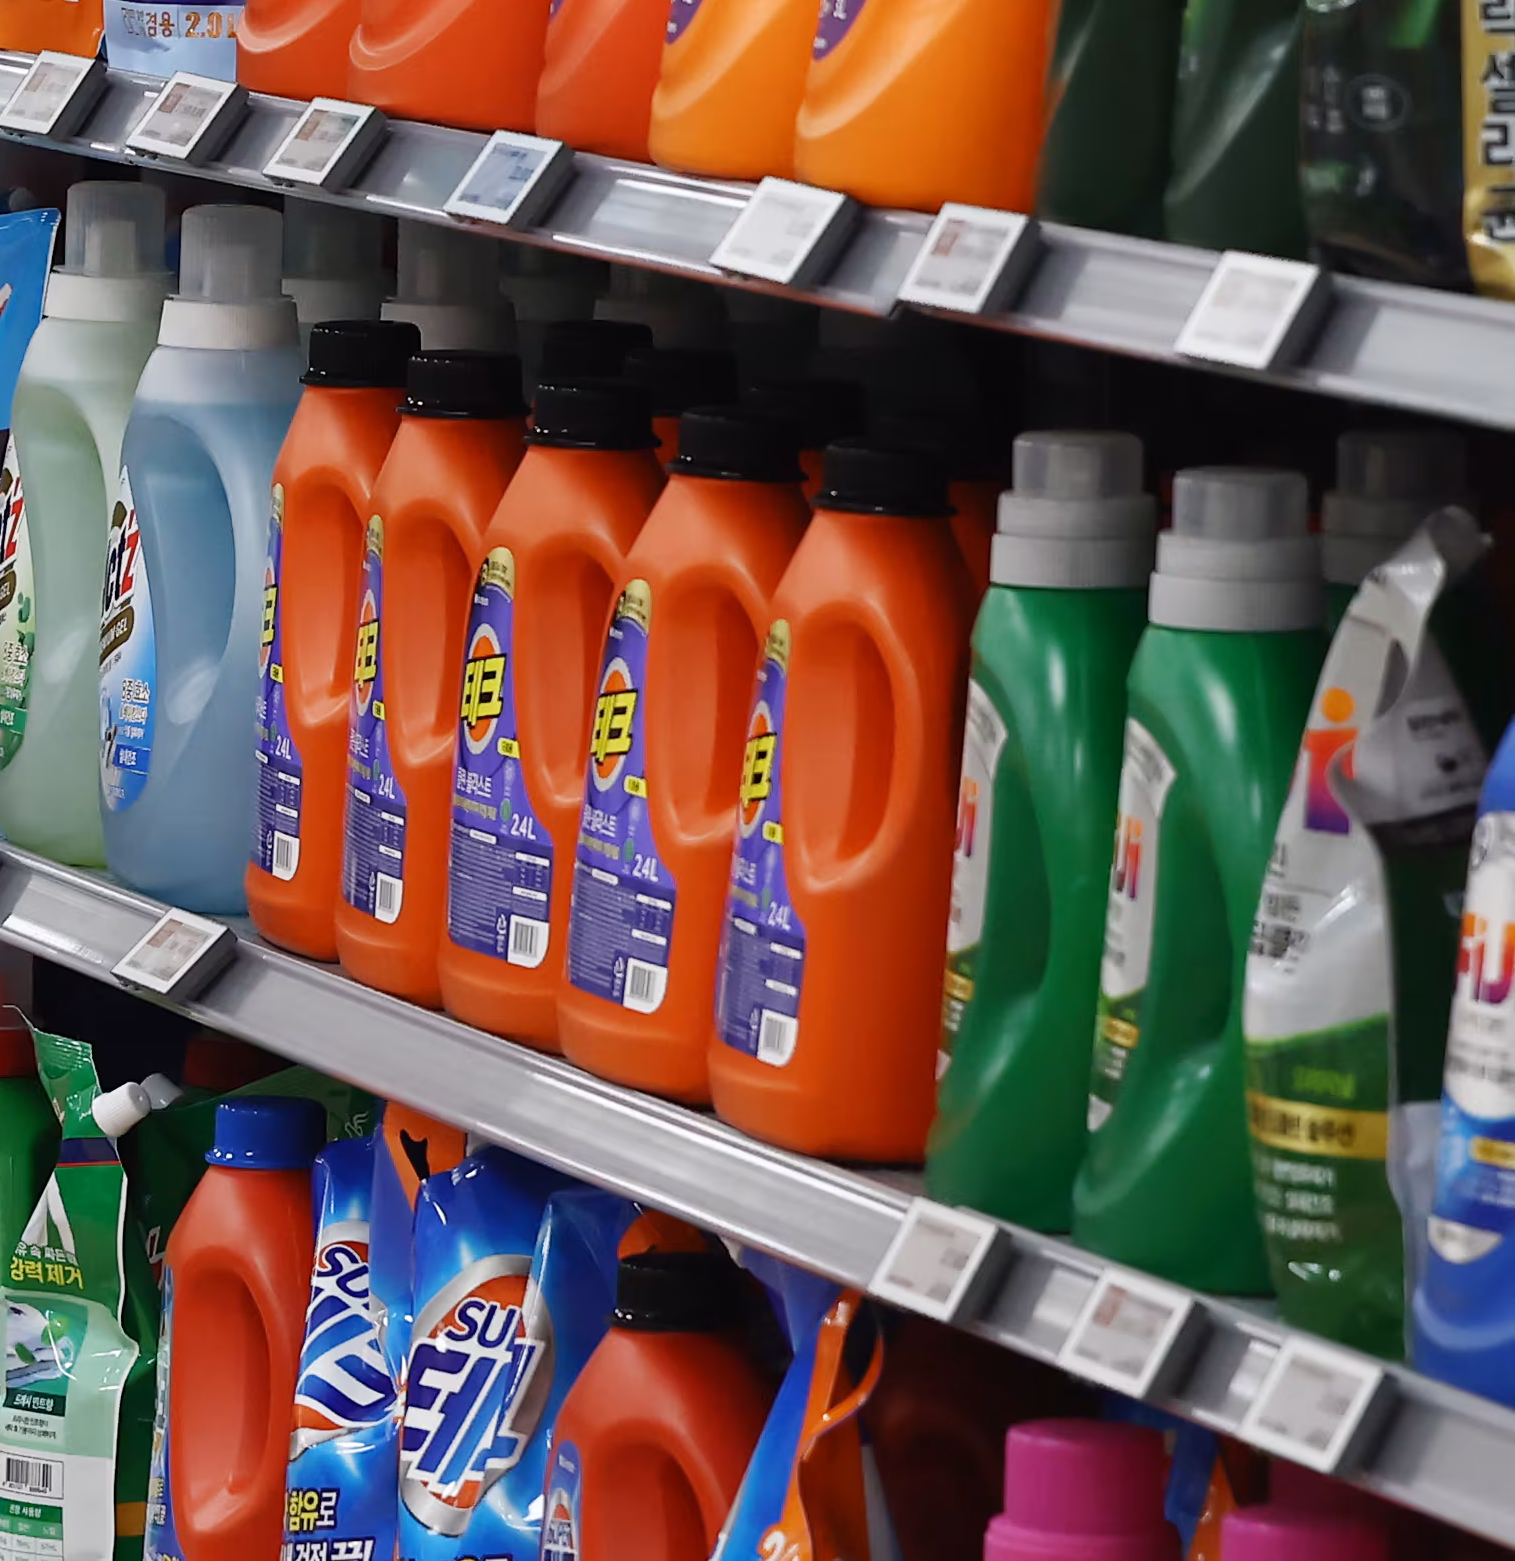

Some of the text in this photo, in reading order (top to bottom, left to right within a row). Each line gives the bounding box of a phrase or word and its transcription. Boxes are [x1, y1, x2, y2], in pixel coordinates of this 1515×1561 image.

[10, 1256, 85, 1290] 강력 제거
[288, 1490, 339, 1533] 함유로
